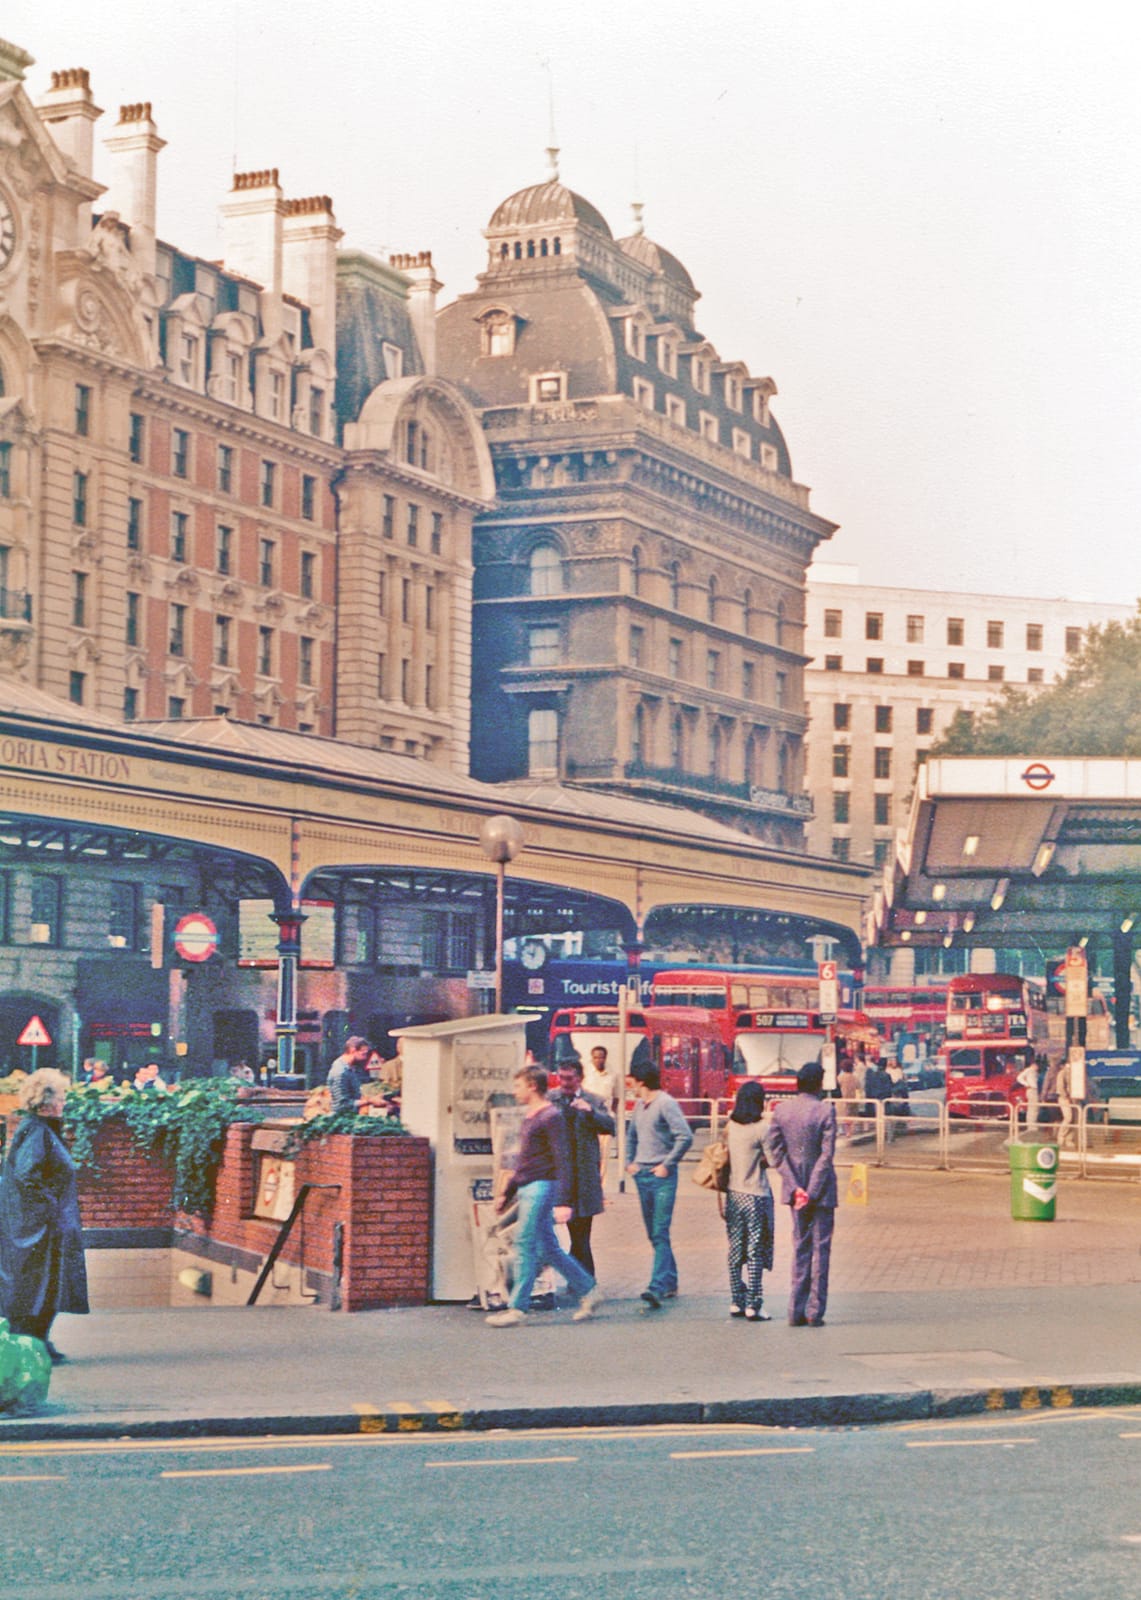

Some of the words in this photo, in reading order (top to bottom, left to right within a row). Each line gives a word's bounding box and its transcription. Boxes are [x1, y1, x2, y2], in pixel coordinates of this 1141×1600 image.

[56, 748, 130, 778] STATION
[821, 964, 834, 979] 6
[562, 979, 619, 995] Tourist
